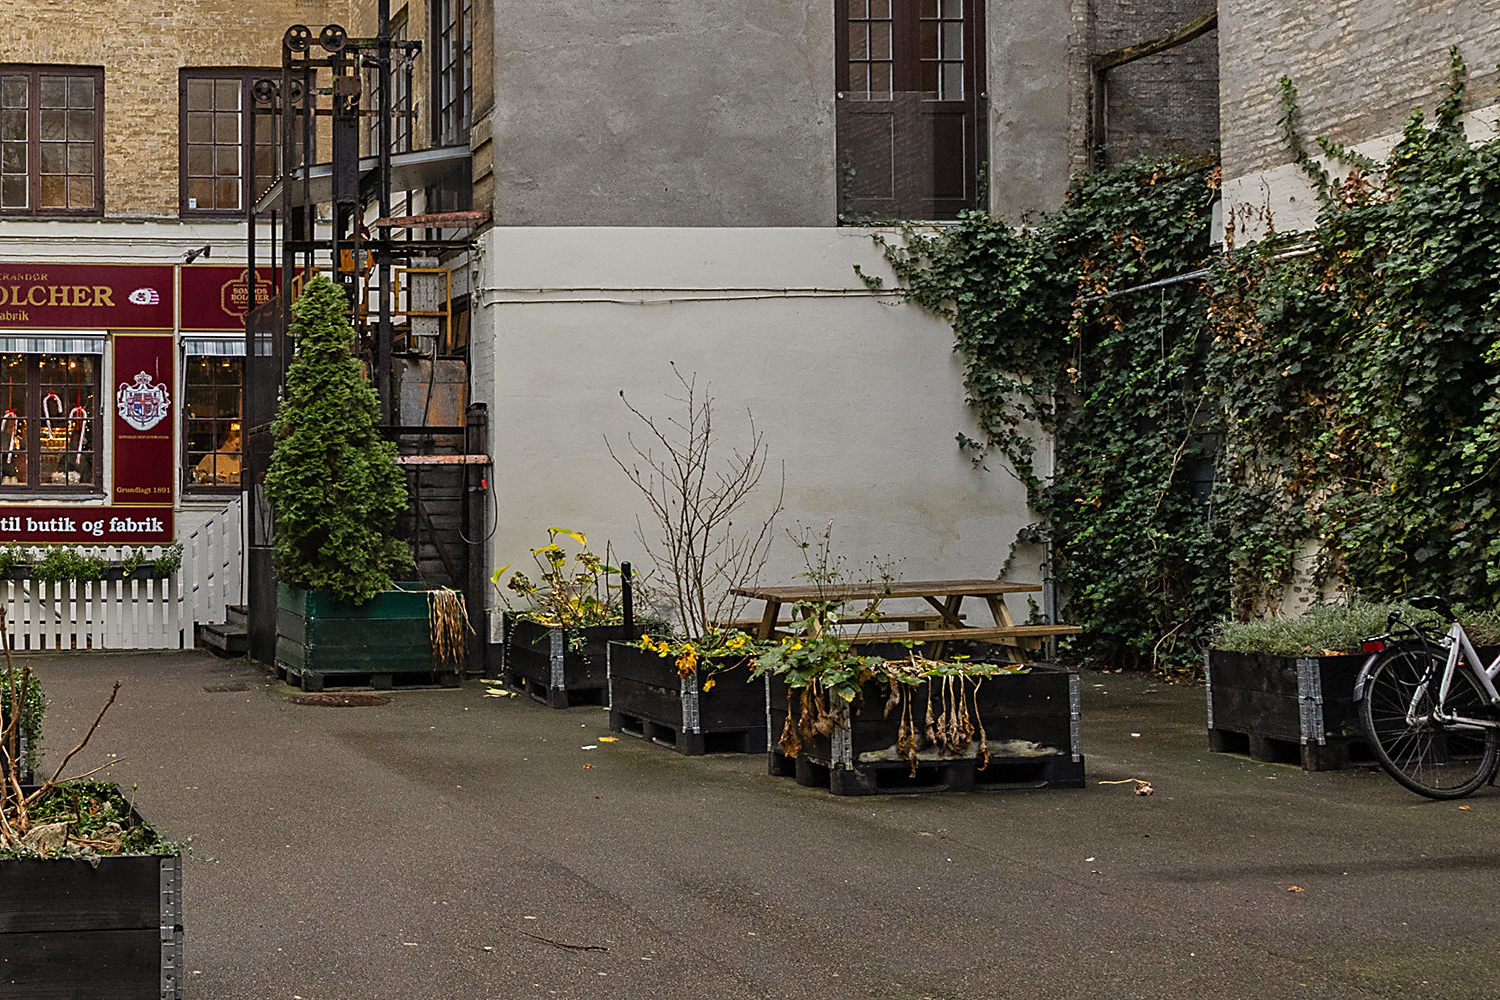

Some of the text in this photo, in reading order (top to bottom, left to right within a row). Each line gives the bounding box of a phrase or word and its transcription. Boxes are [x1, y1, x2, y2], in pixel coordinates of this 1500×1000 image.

[116, 486, 151, 495] Grundlagt
[1, 516, 21, 532] til
[27, 516, 77, 532] butik
[82, 521, 104, 536] og
[109, 517, 164, 533] fabrik
